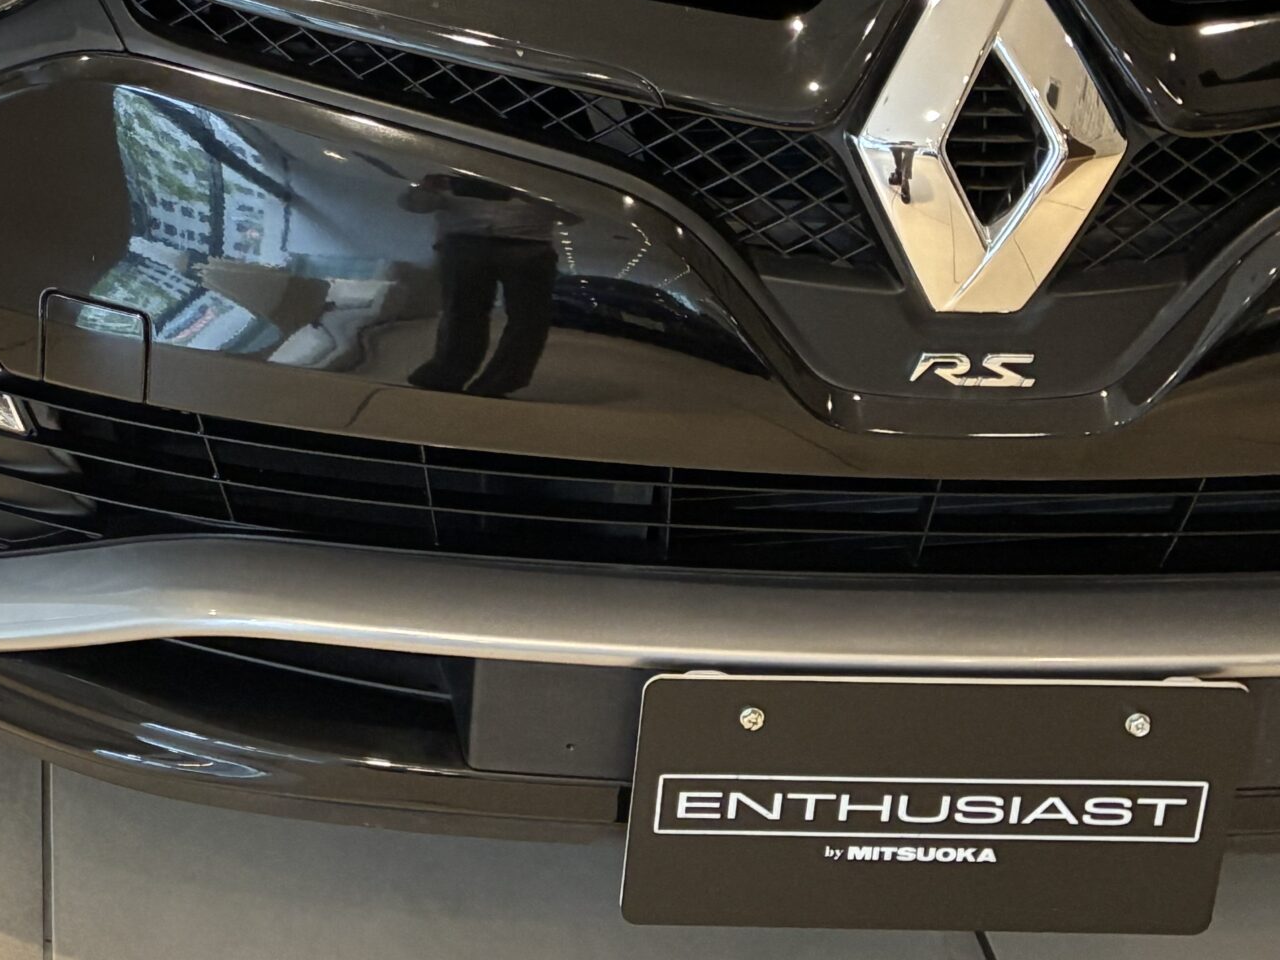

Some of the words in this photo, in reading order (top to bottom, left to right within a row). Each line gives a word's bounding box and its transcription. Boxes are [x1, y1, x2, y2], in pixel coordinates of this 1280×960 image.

[675, 792, 1188, 826] ENTHUSIAST
[824, 846, 844, 861] by
[846, 846, 998, 863] MITSUOKA
